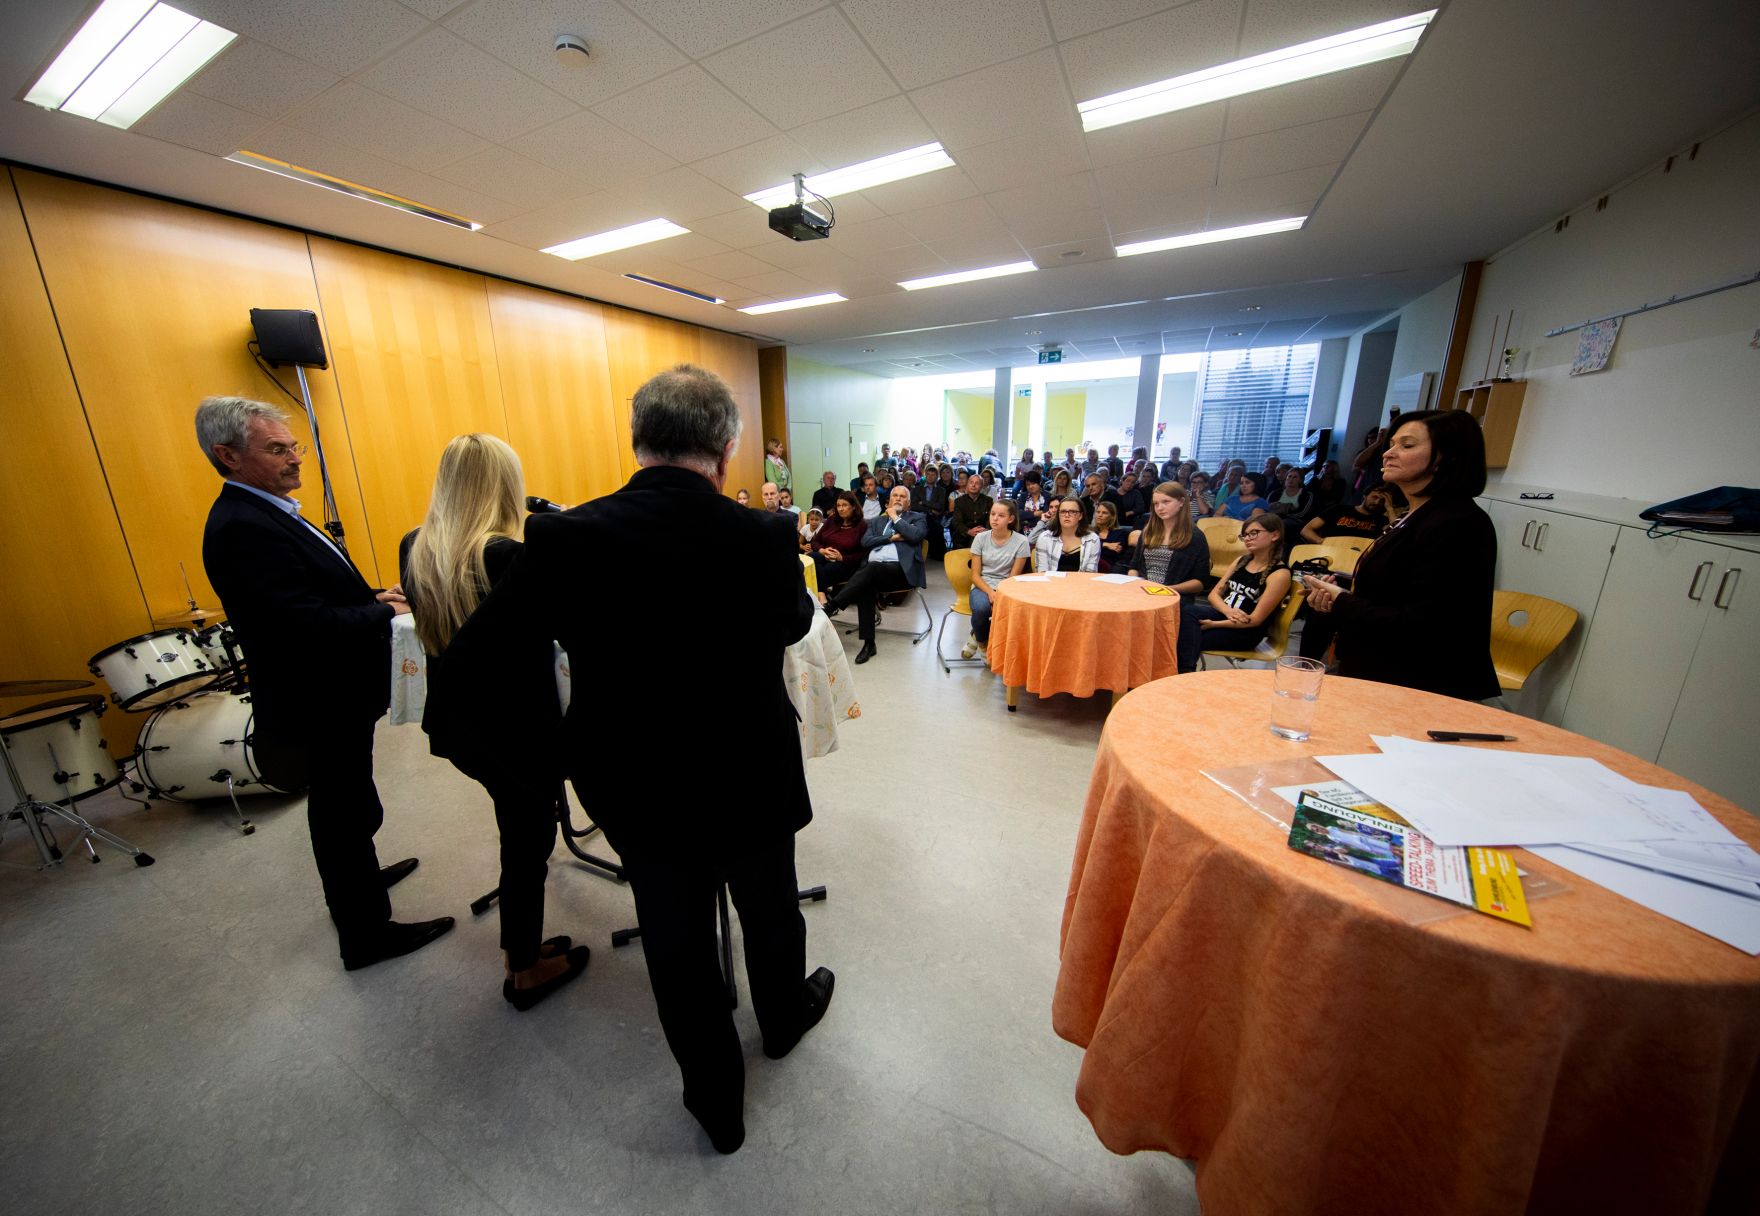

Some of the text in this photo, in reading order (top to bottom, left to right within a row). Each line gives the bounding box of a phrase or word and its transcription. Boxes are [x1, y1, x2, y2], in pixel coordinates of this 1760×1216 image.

[1312, 800, 1404, 834] EINLADUNG
[1408, 831, 1424, 888] SPEED-TALKING
[1425, 859, 1436, 877] THEMA
[1426, 878, 1438, 893] ZUM
